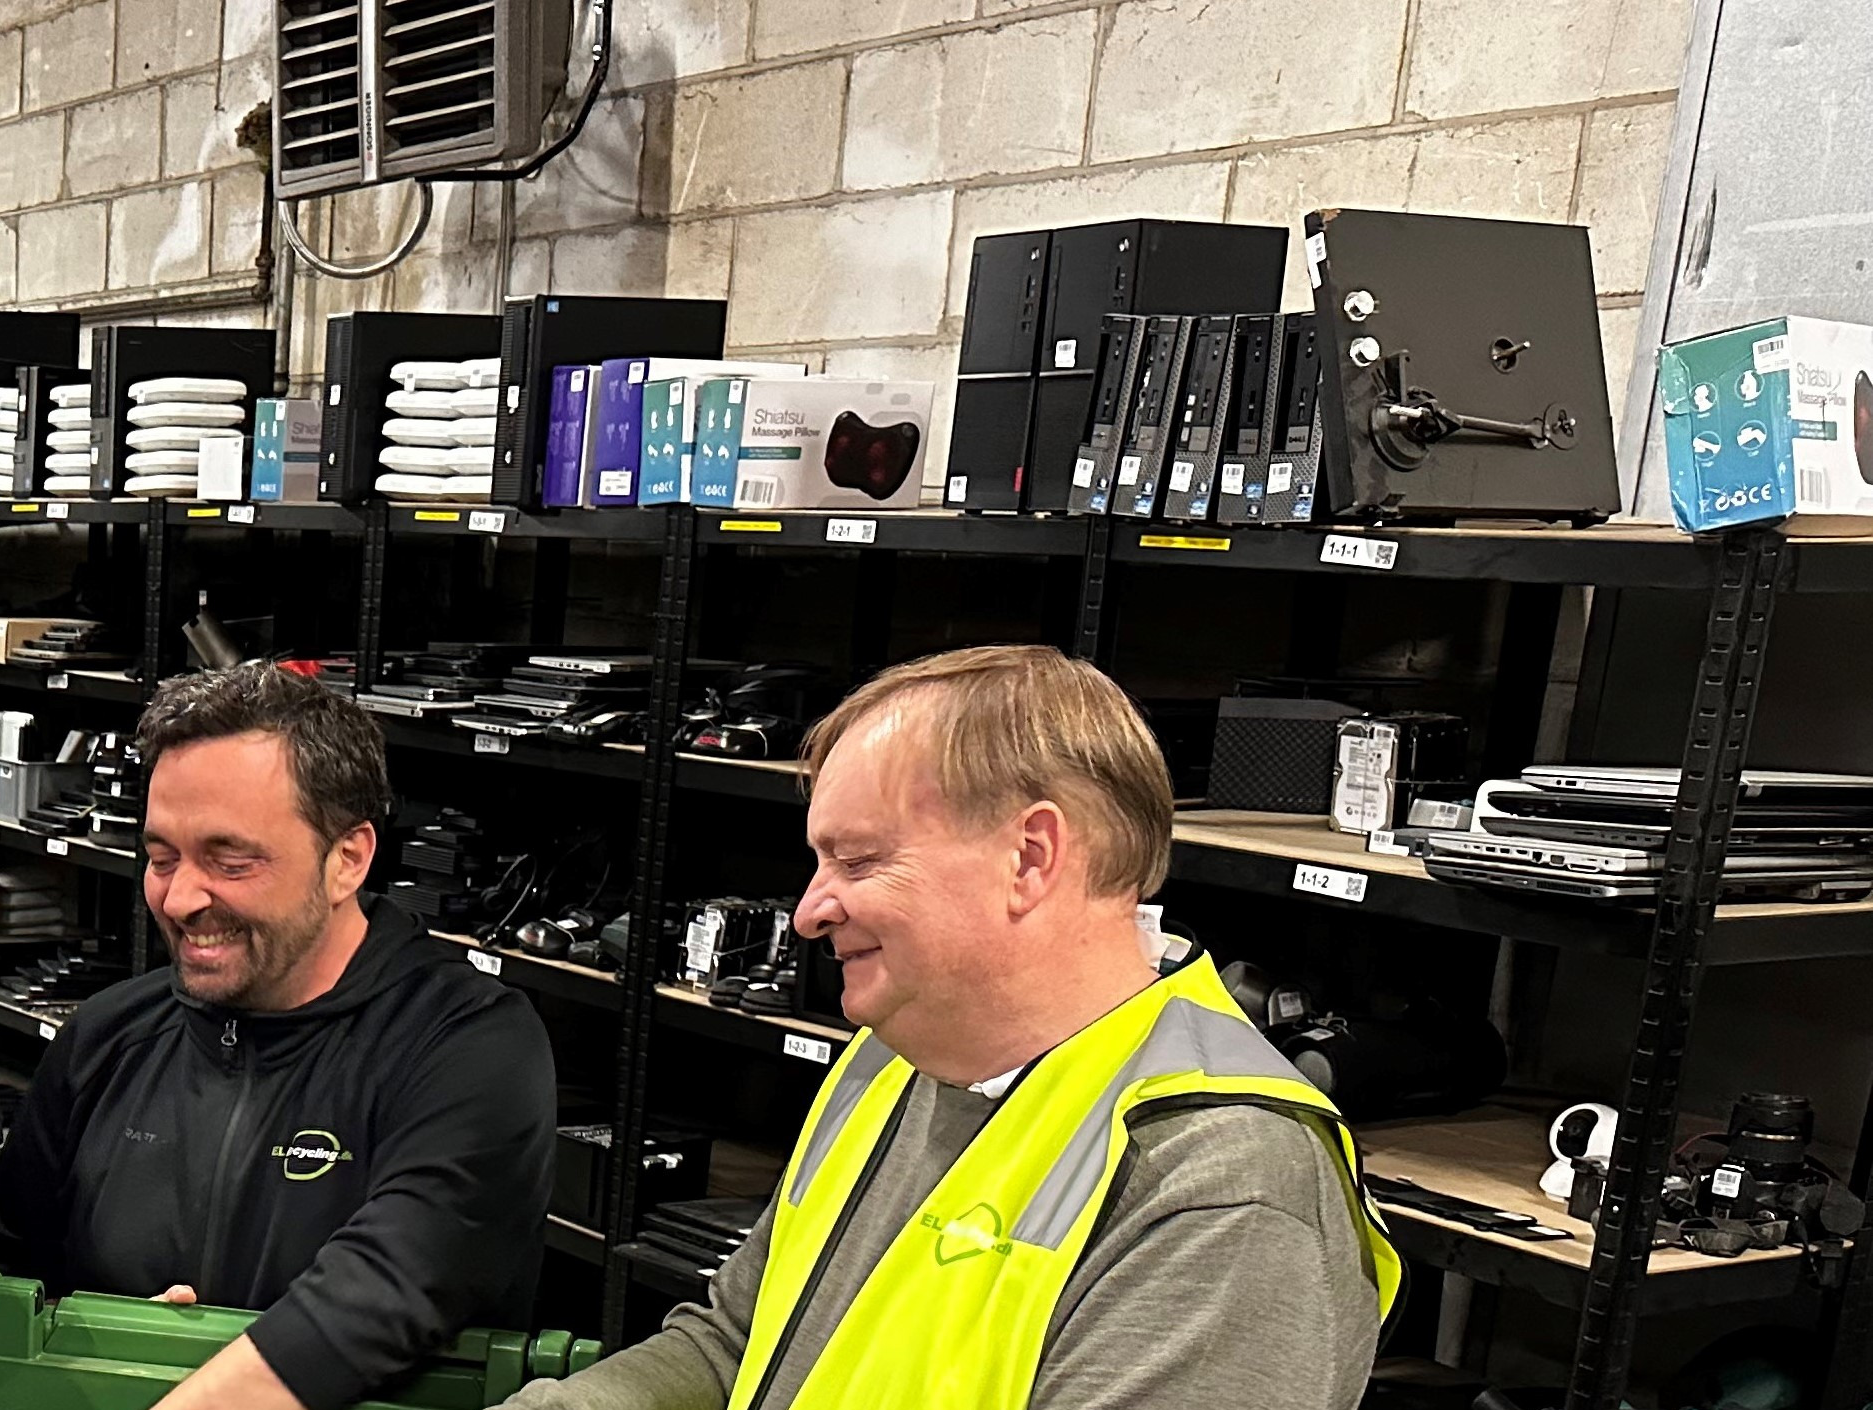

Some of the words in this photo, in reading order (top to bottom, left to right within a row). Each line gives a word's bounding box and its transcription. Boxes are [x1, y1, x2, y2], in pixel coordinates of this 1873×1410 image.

[754, 408, 805, 425] Shiatsu
[751, 427, 793, 438] Massage
[794, 427, 821, 438] Pillow
[830, 525, 851, 536] 1-2-1
[1329, 542, 1358, 558] 1-1-1
[1301, 871, 1330, 888] 1-1-2
[919, 1212, 943, 1232] EL
